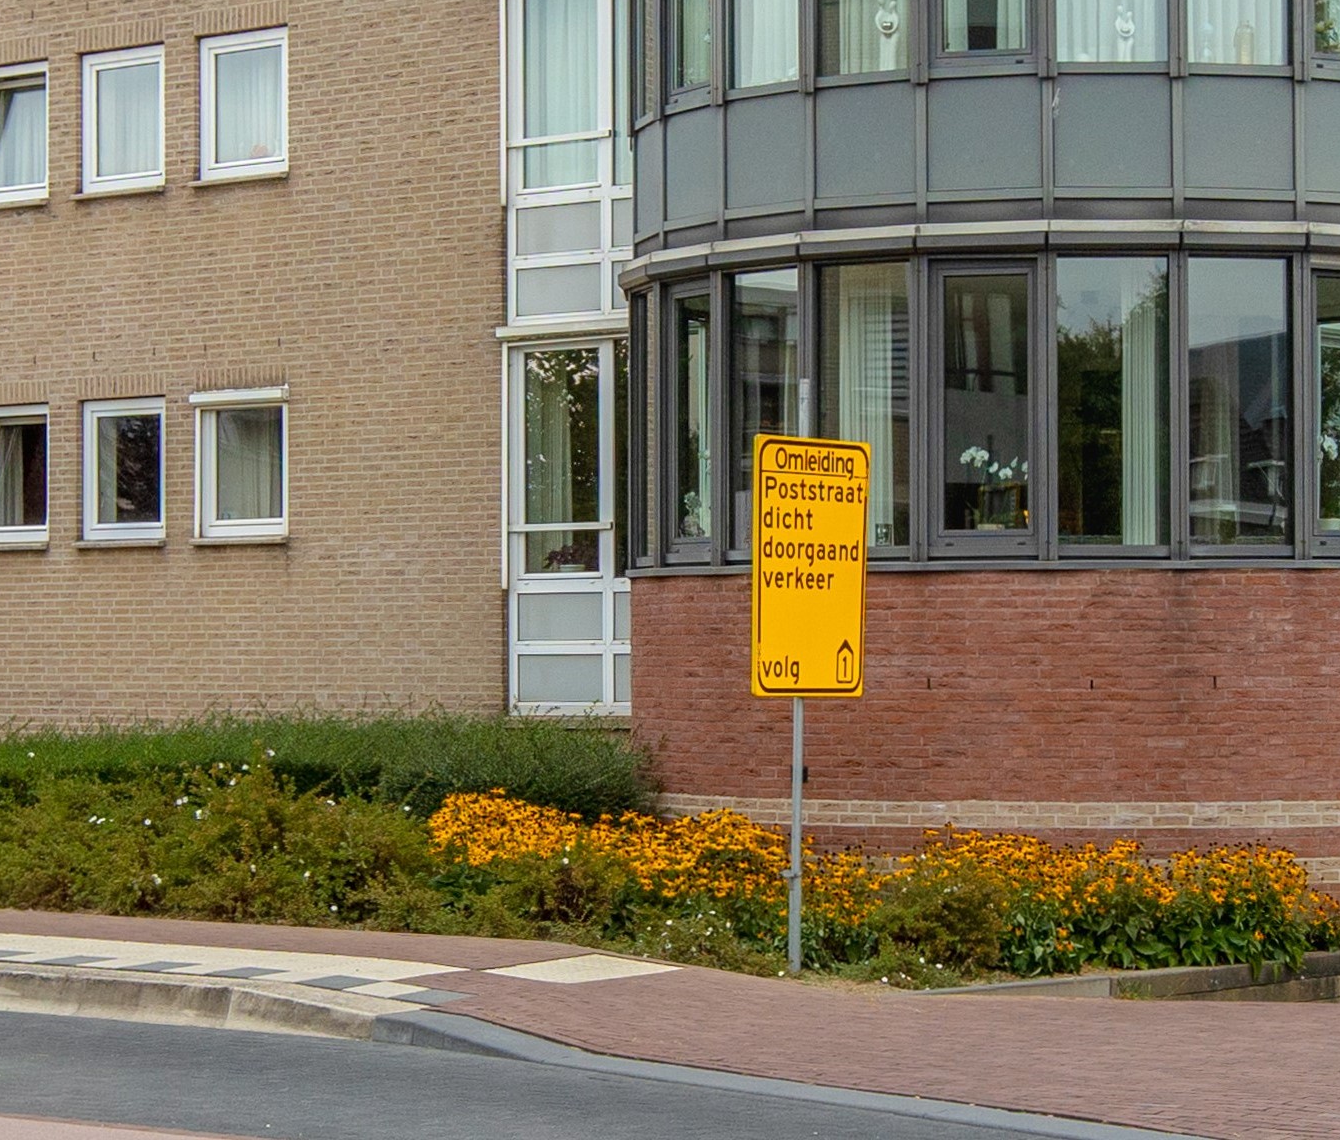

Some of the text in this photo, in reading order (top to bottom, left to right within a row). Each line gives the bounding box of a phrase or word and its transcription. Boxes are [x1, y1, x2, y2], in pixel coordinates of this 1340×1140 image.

[775, 447, 855, 480] Omleiding
[765, 476, 864, 504] Poststraat
[763, 506, 813, 531] dicht
[763, 536, 860, 566] doorgaand
[763, 567, 835, 590] verkeer
[762, 656, 800, 685] volg
[842, 656, 848, 679] 1
